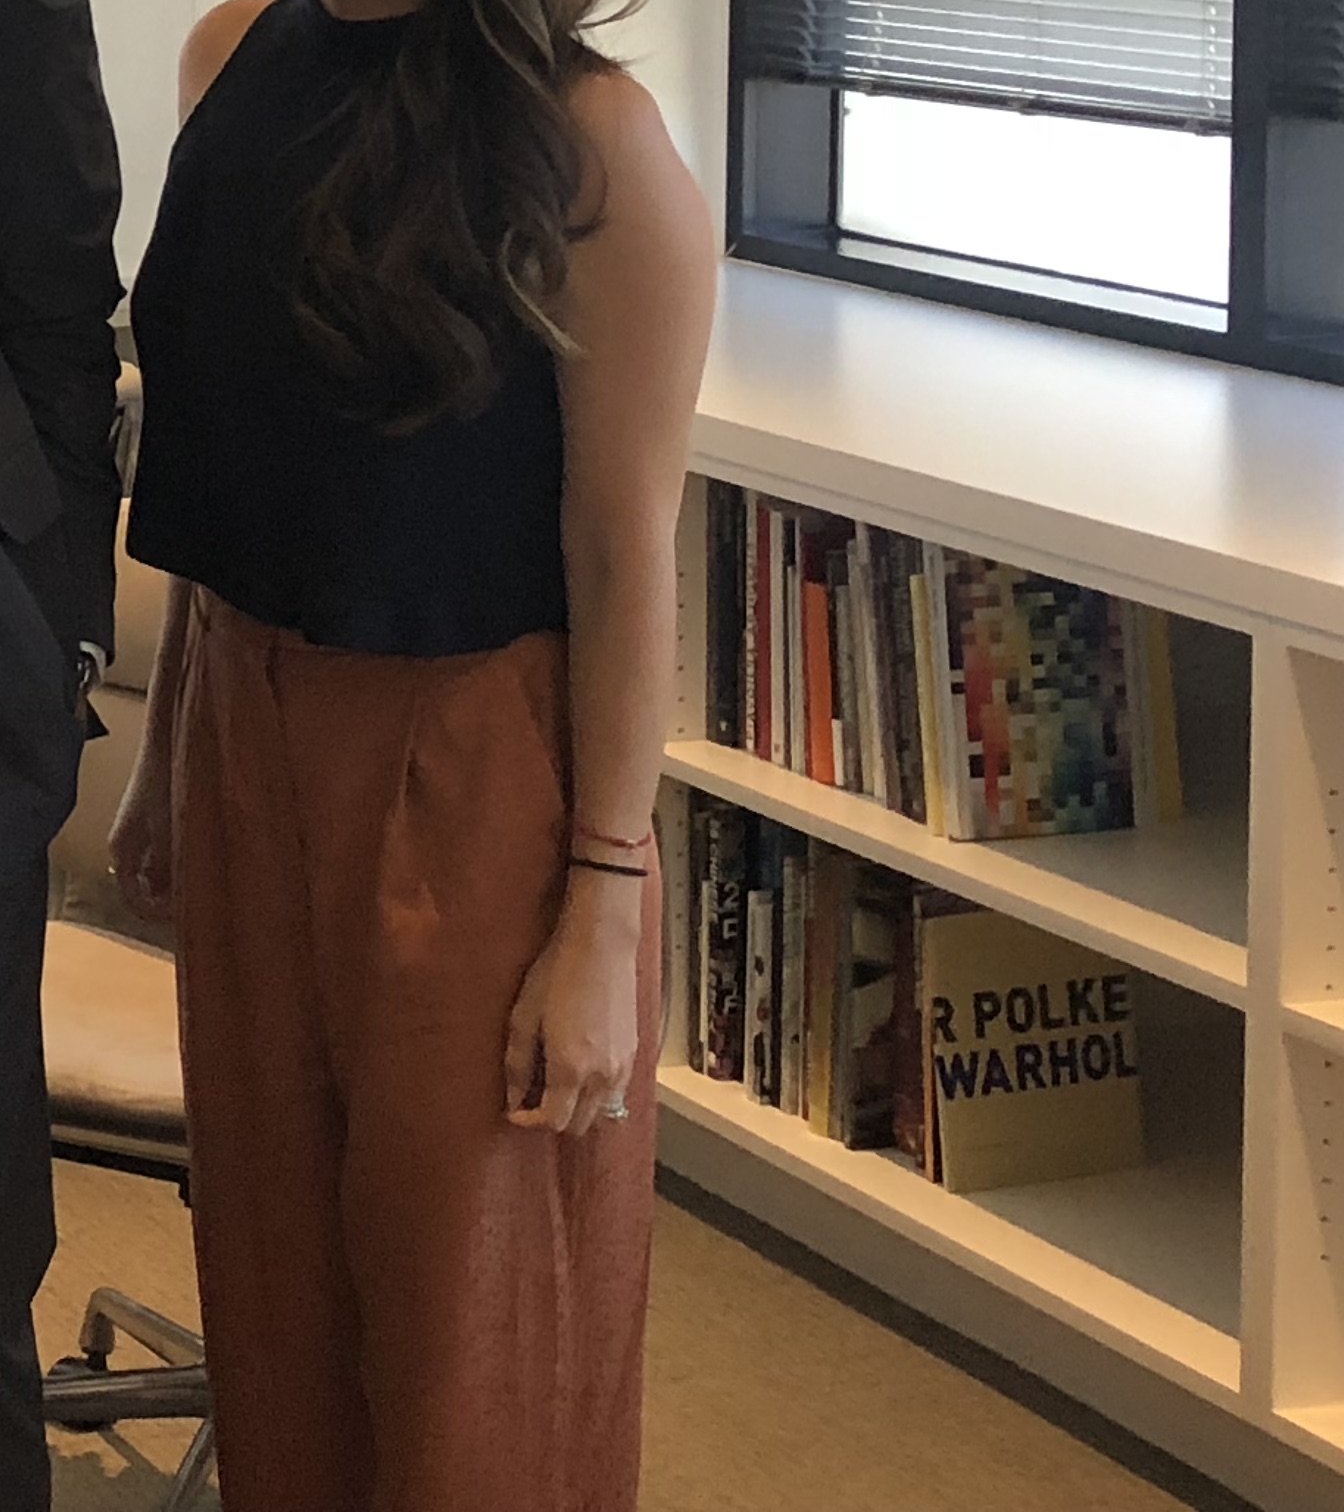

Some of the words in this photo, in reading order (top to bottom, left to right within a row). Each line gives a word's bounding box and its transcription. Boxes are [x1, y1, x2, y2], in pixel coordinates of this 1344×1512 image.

[932, 996, 957, 1042] R
[974, 973, 1131, 1039] POLKE
[935, 1031, 1139, 1099] WARHOL
